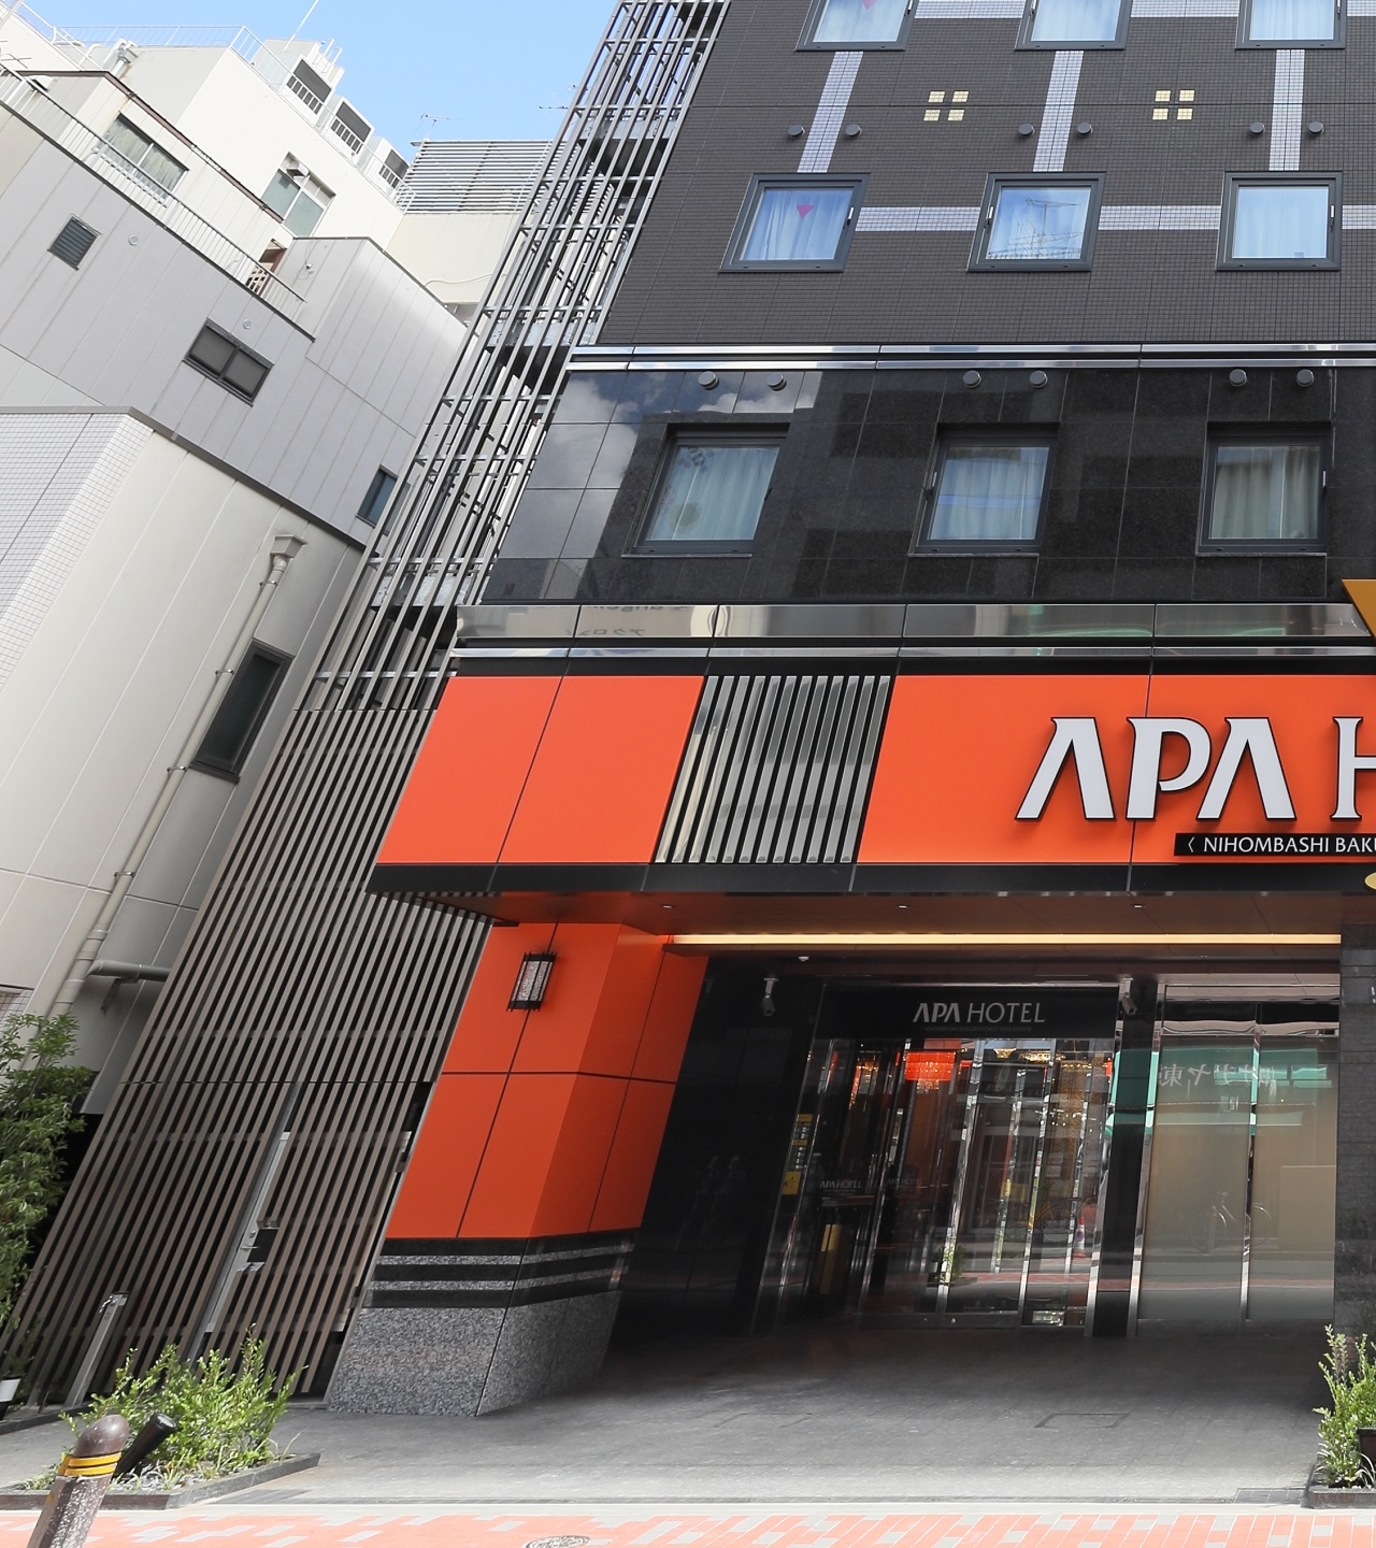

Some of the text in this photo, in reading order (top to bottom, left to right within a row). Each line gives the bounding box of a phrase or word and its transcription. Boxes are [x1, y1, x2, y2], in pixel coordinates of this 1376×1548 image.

[1015, 716, 1297, 821] APA
[1203, 836, 1329, 853] NIHOMBASHI
[913, 1002, 1046, 1023] APA HOTEL
[836, 1180, 862, 1189] HOTEL
